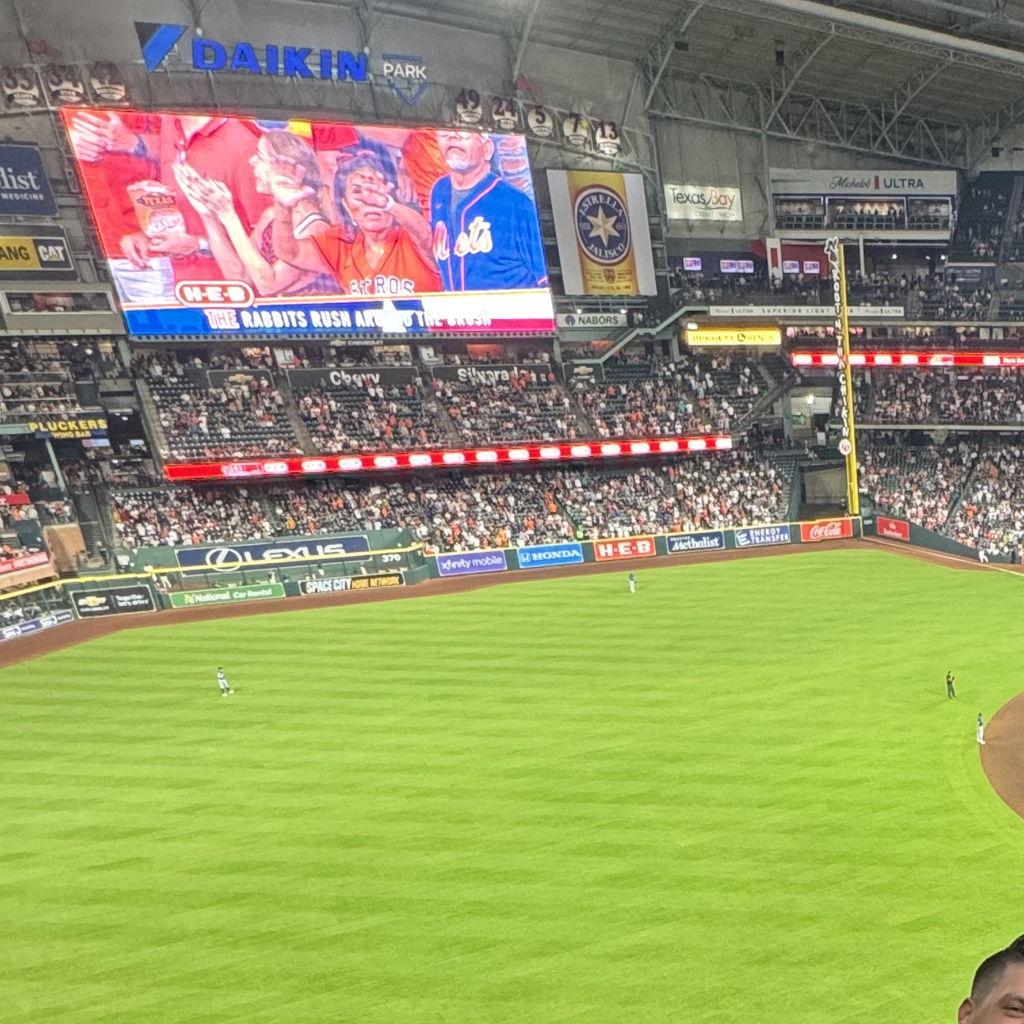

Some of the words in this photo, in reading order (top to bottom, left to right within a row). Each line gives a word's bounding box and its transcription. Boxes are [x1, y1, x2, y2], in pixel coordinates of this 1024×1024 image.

[191, 36, 369, 81] DAIKIN
[383, 61, 427, 79] PARK
[883, 177, 925, 188] ULTRA
[579, 192, 623, 216] ESTRELLA
[670, 187, 706, 205] Texas
[706, 189, 735, 210] Bay
[38, 244, 65, 262] CAT
[588, 242, 625, 260] JALISCO
[204, 308, 240, 329] THE
[241, 310, 308, 328] RABBITS
[309, 310, 351, 328] RUSH
[578, 316, 619, 325] NABORS
[28, 419, 108, 432] PLUCKERS
[52, 431, 74, 439] WING
[75, 430, 92, 438] BAR
[246, 542, 346, 563] LEXUS
[382, 554, 402, 563] 370
[532, 549, 581, 560] HONDA
[441, 558, 471, 570] xfinity
[472, 555, 503, 567] mobile
[305, 579, 333, 594] SPACE
[333, 577, 351, 591] CITY
[195, 591, 230, 603] National
